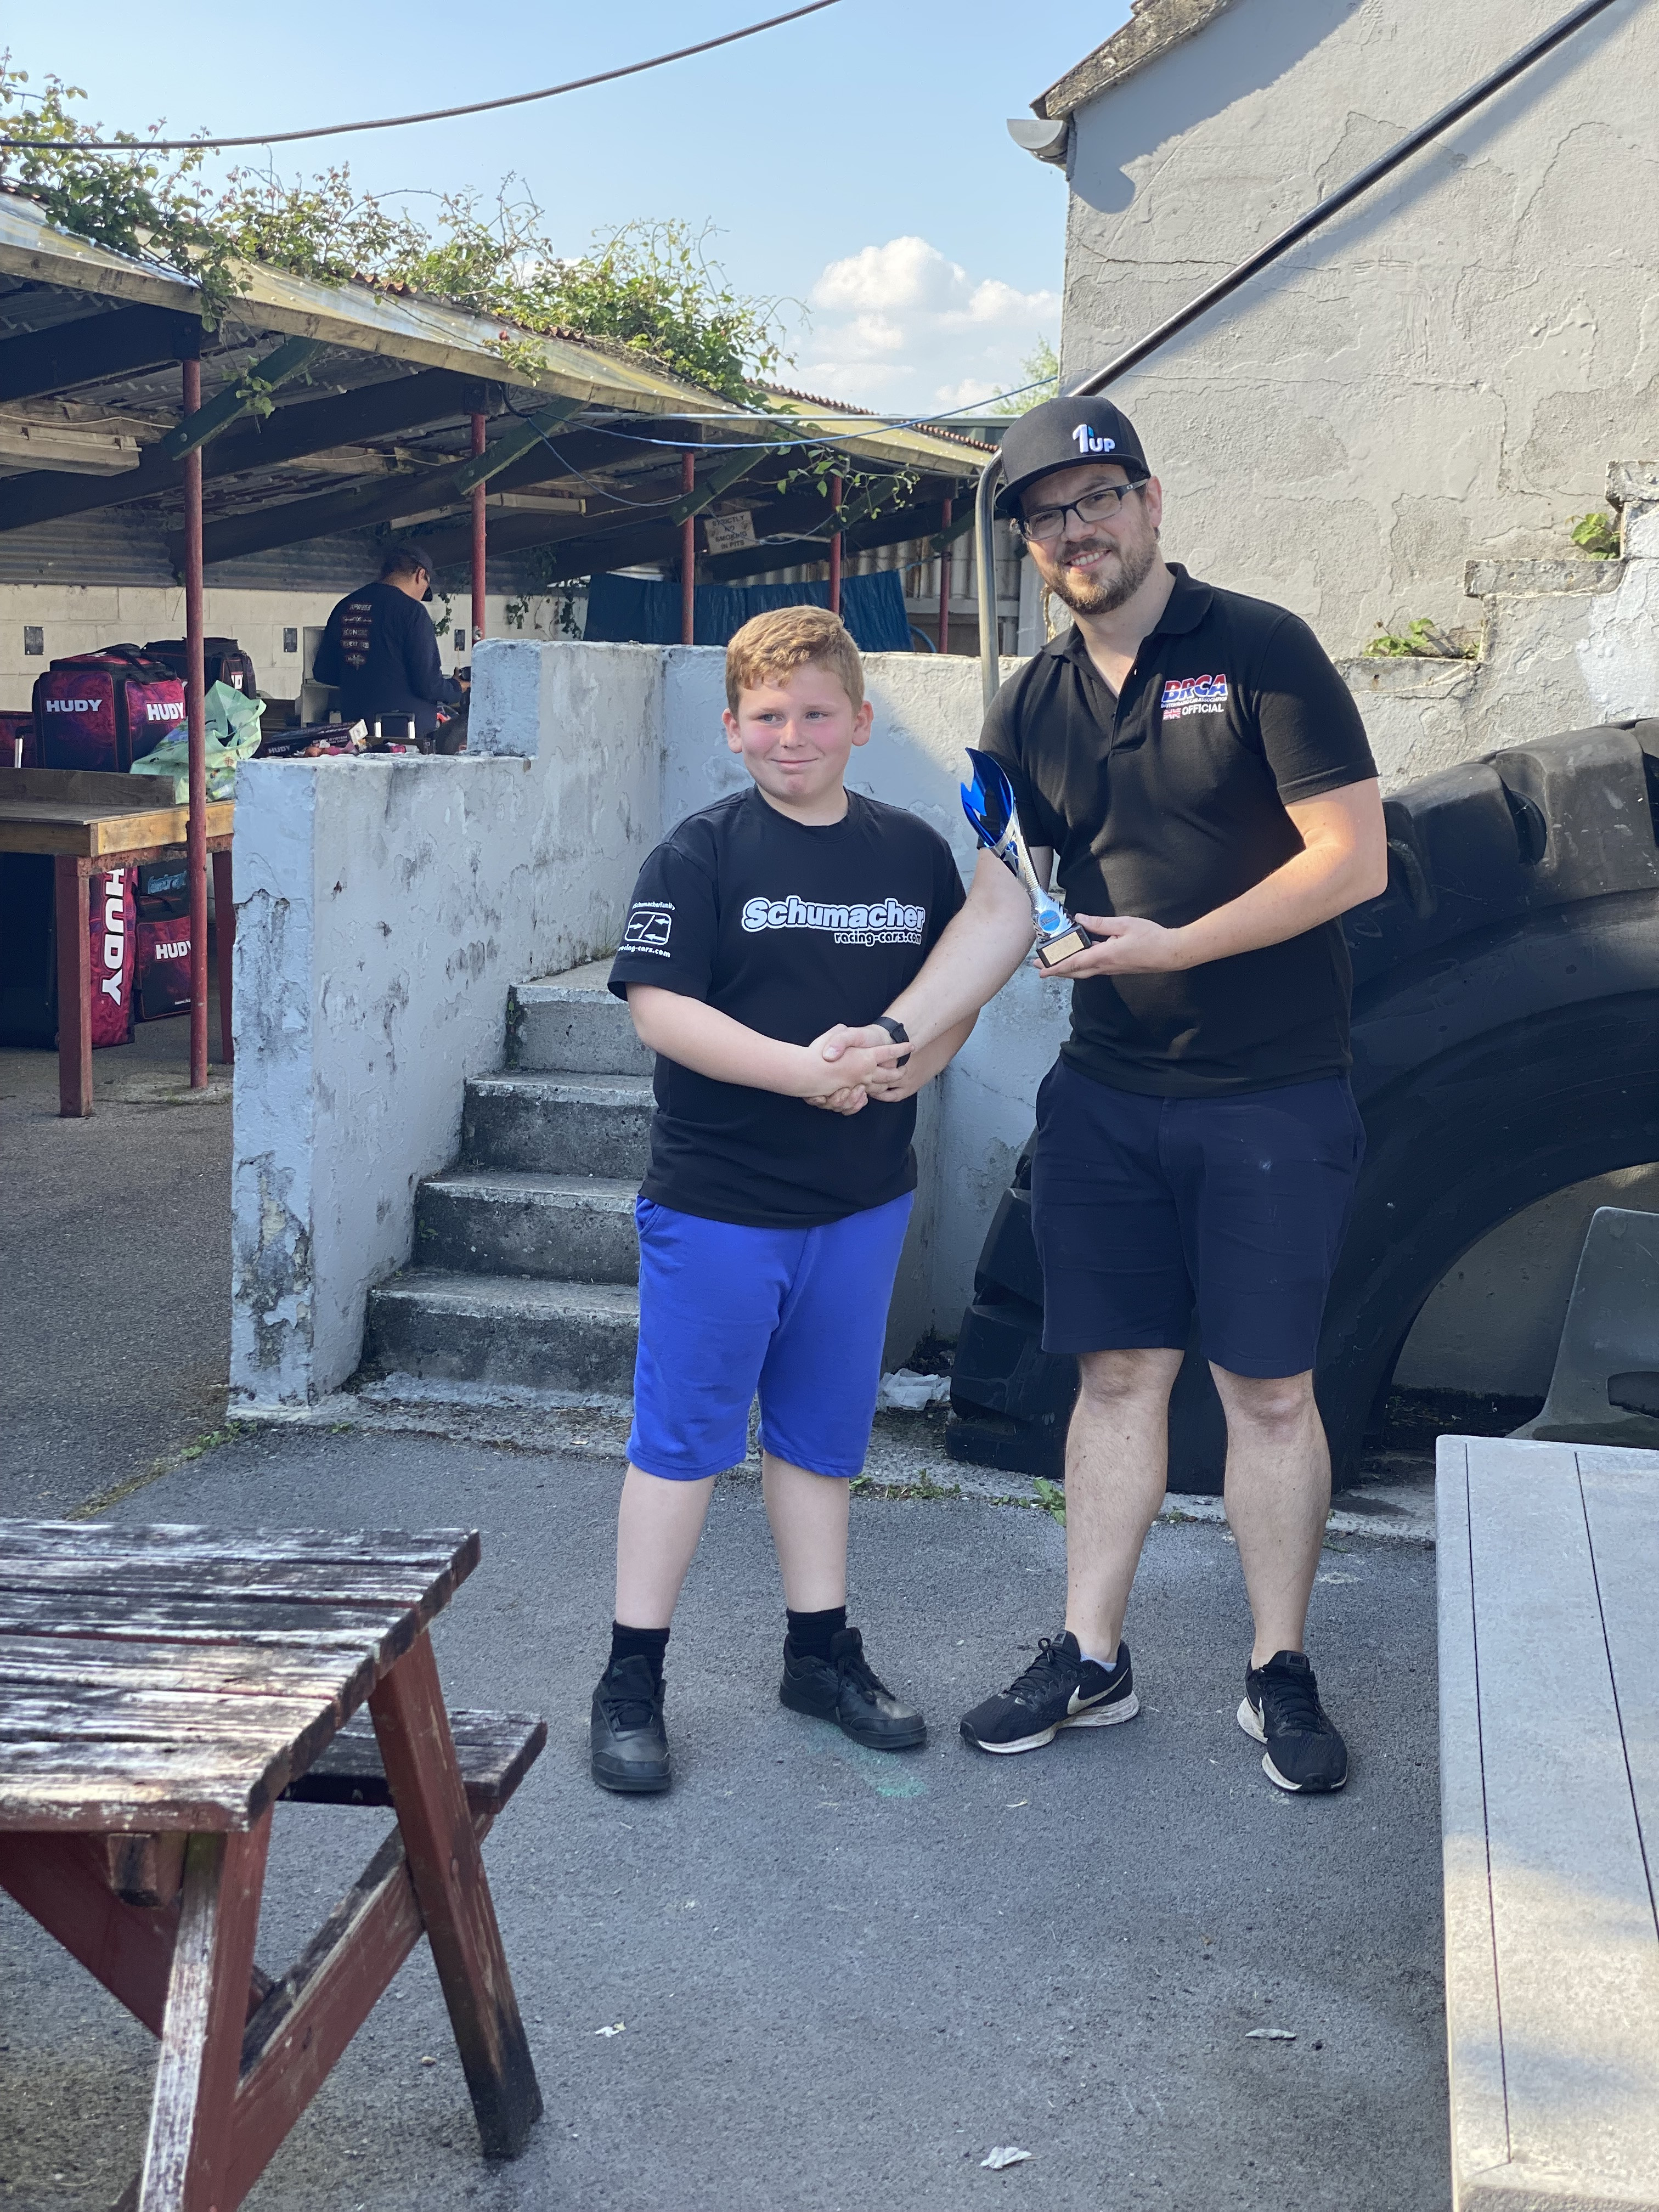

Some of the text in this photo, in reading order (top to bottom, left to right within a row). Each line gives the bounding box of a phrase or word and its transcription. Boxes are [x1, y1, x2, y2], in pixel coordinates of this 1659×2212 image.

[729, 540, 744, 548] PITS
[1161, 674, 1228, 703] BRCA
[46, 699, 103, 712] HUDY
[146, 702, 184, 721] HUDY
[1182, 703, 1224, 715] OFFICIAL
[268, 745, 291, 754] HUDY
[742, 895, 925, 932] Schumacher
[102, 868, 125, 1006] HUDY
[834, 932, 922, 947] racing-cars.com
[618, 944, 671, 958] racing-cars.com
